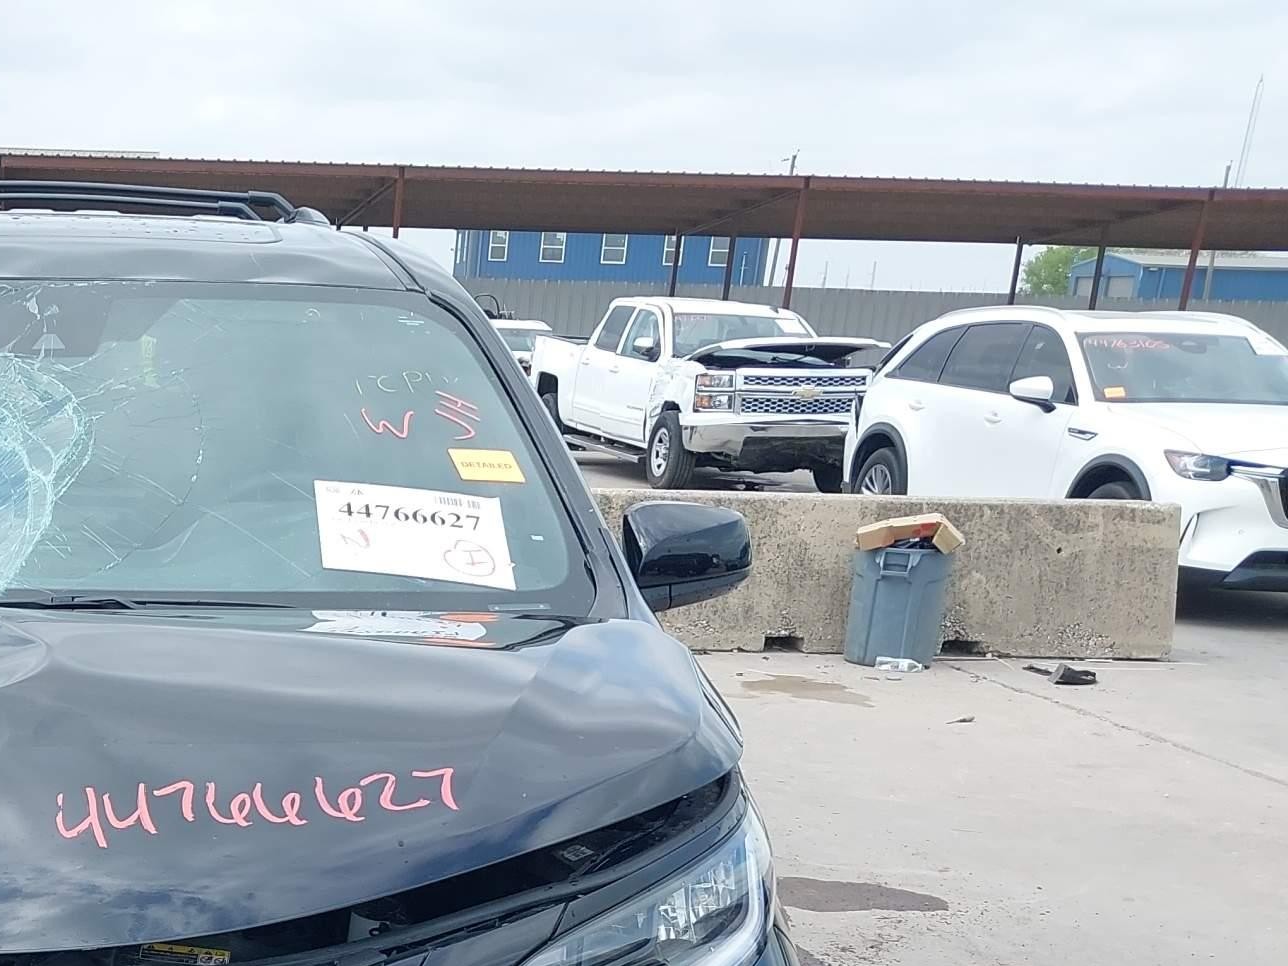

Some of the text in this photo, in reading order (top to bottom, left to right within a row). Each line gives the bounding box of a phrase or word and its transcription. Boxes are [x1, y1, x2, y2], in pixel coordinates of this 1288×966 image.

[460, 461, 513, 470] DETAILED
[338, 501, 481, 532] 44766627
[55, 767, 460, 848] 44766627
